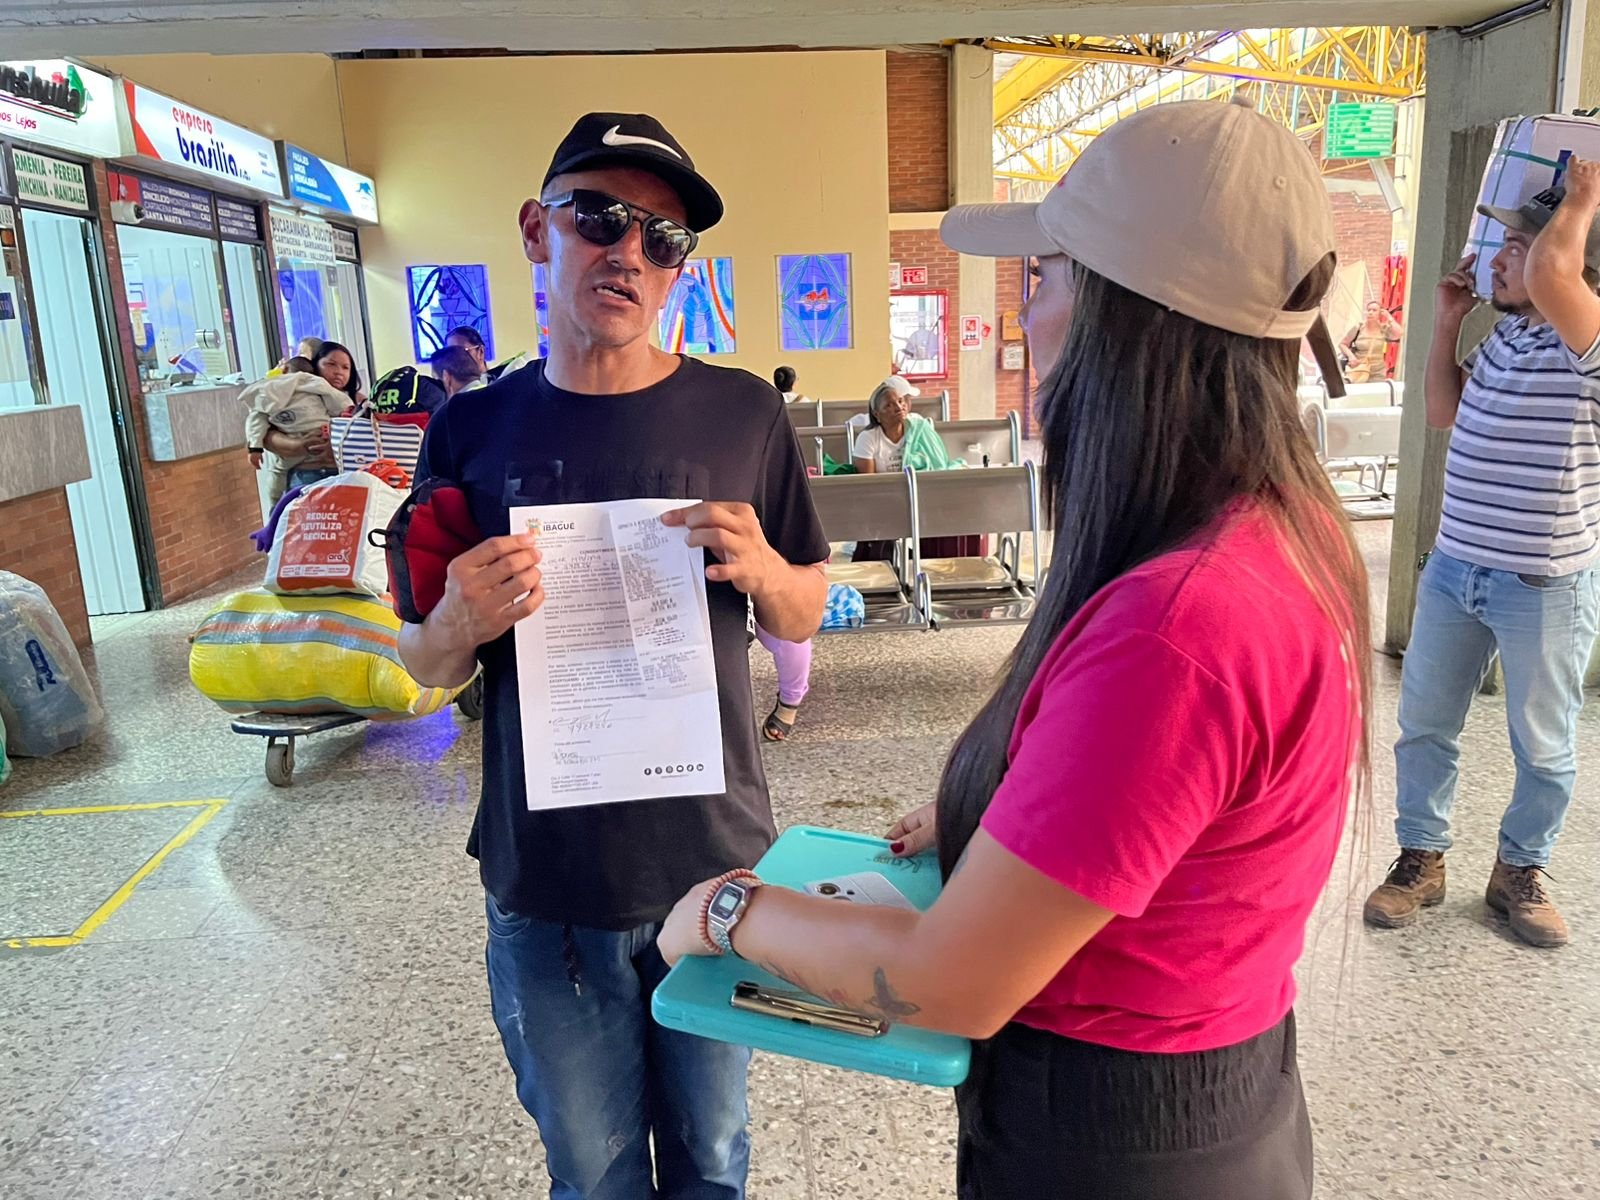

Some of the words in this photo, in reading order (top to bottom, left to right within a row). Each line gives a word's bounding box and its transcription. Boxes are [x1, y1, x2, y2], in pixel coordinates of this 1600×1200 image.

[176, 127, 239, 177] brasilia
[53, 162, 84, 184] PEREIRA
[306, 512, 339, 520] REDUCE
[301, 522, 342, 530] REUTILIZA
[303, 532, 337, 540] RECICLA
